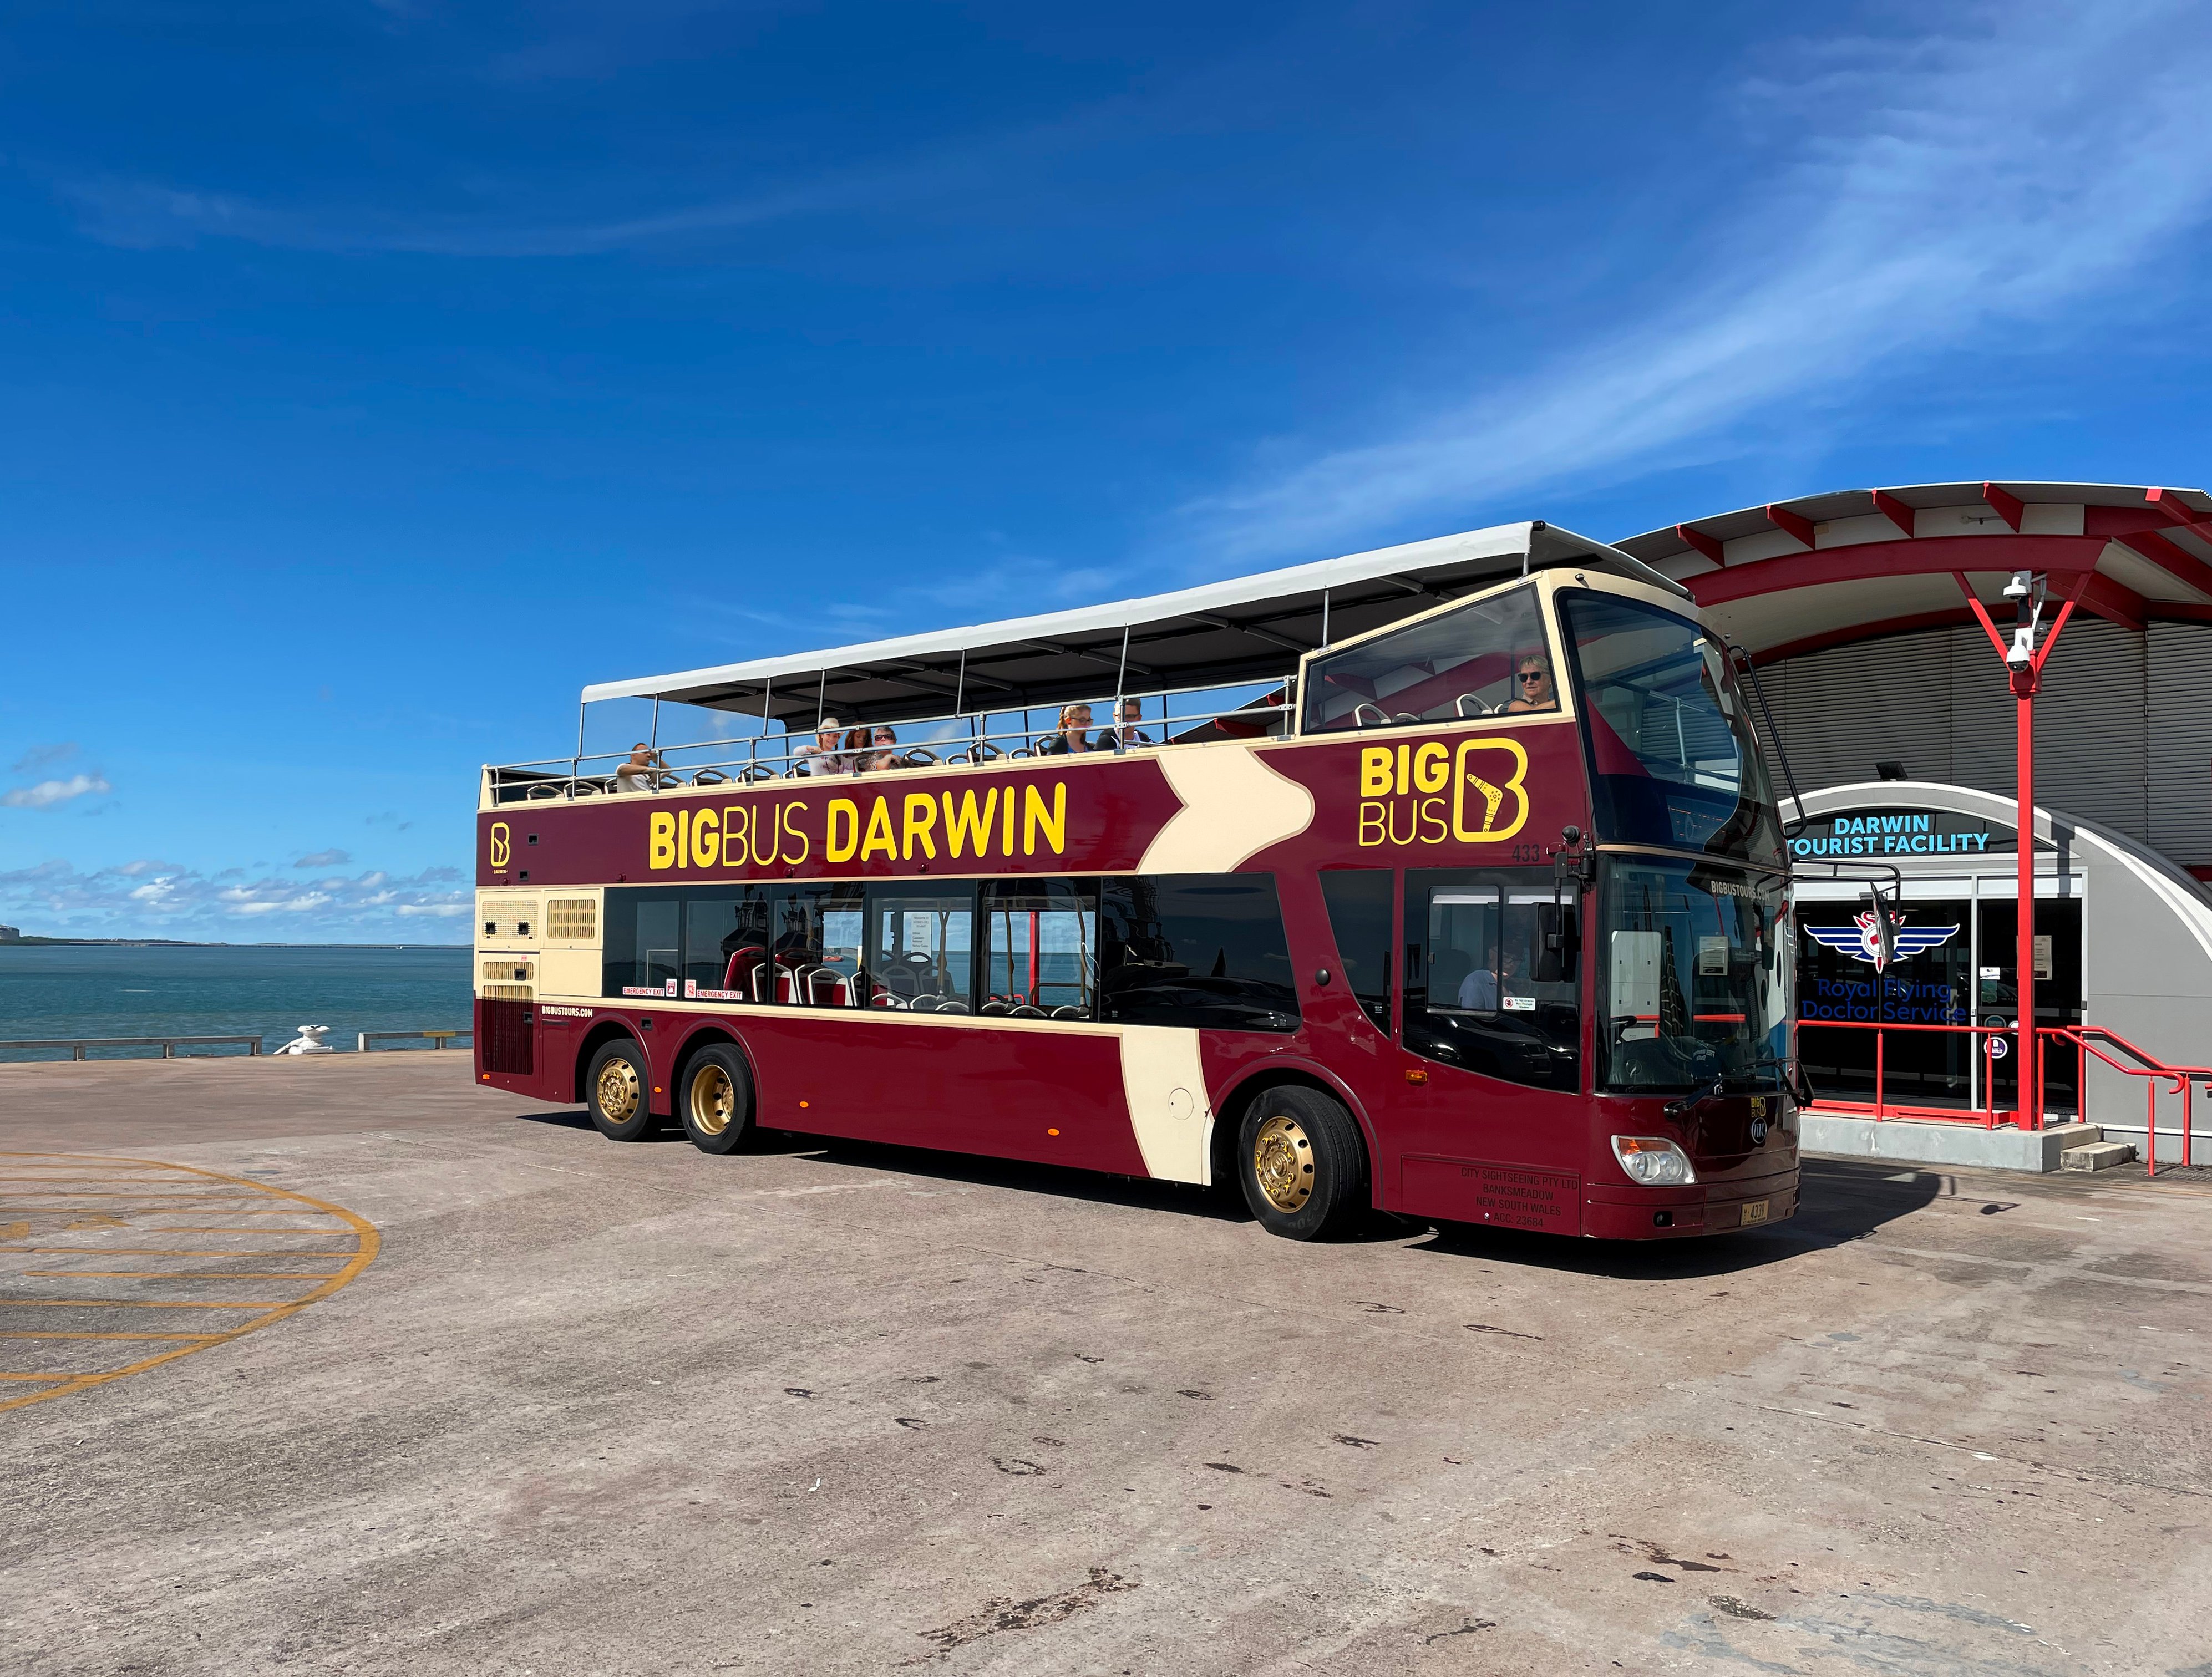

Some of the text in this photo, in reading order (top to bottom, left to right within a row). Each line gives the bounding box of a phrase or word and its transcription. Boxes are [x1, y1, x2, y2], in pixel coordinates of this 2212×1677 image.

[1361, 742, 1449, 797] BIG
[826, 782, 1066, 862] DARWIN
[1359, 797, 1448, 846] BUS
[1835, 815, 1929, 835] DARWIN
[1511, 844, 1540, 862] 433
[1884, 833, 1990, 853] FACILITY
[1711, 880, 1770, 901] BIGBUSTOURS.COM
[697, 990, 728, 998] EMERGENCY
[1818, 979, 1951, 1003] Royal Flying
[541, 1005, 593, 1018] BIGBUSTOURS.COM
[1802, 1000, 1966, 1022] Doctor Service
[1751, 1097, 1759, 1107] BIG
[1751, 1109, 1760, 1117] BUS
[1461, 1167, 1577, 1190] CITY SIGHTSEEING PTY LTD
[1483, 1183, 1554, 1201] BANKSMEADOW
[1476, 1196, 1561, 1216] NEW SOUTH WALES
[1750, 1202, 1765, 1219] 4339
[1494, 1212, 1543, 1227] ACC: 23684
